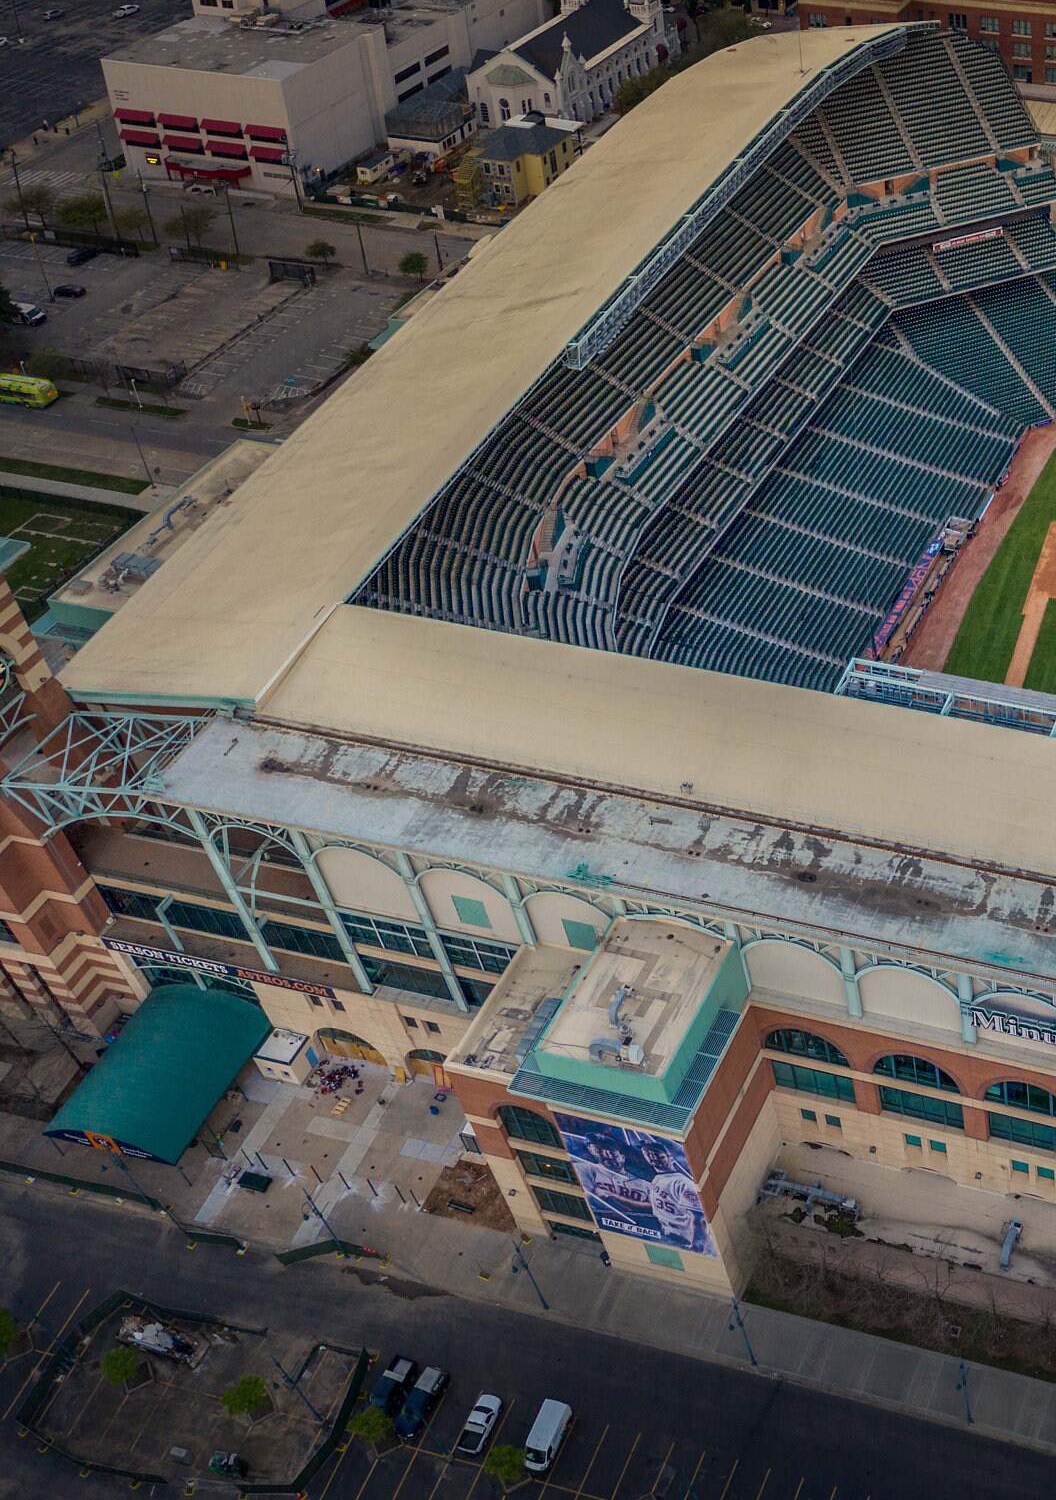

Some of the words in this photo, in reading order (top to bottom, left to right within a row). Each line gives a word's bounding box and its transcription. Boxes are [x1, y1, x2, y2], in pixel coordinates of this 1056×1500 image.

[110, 940, 165, 961] SEASON
[167, 951, 228, 974] TICKETS
[236, 969, 329, 997] ASTROS.COM
[656, 1198, 676, 1214] 35
[604, 1219, 624, 1228] TAKE
[636, 1227, 659, 1237] BACK
